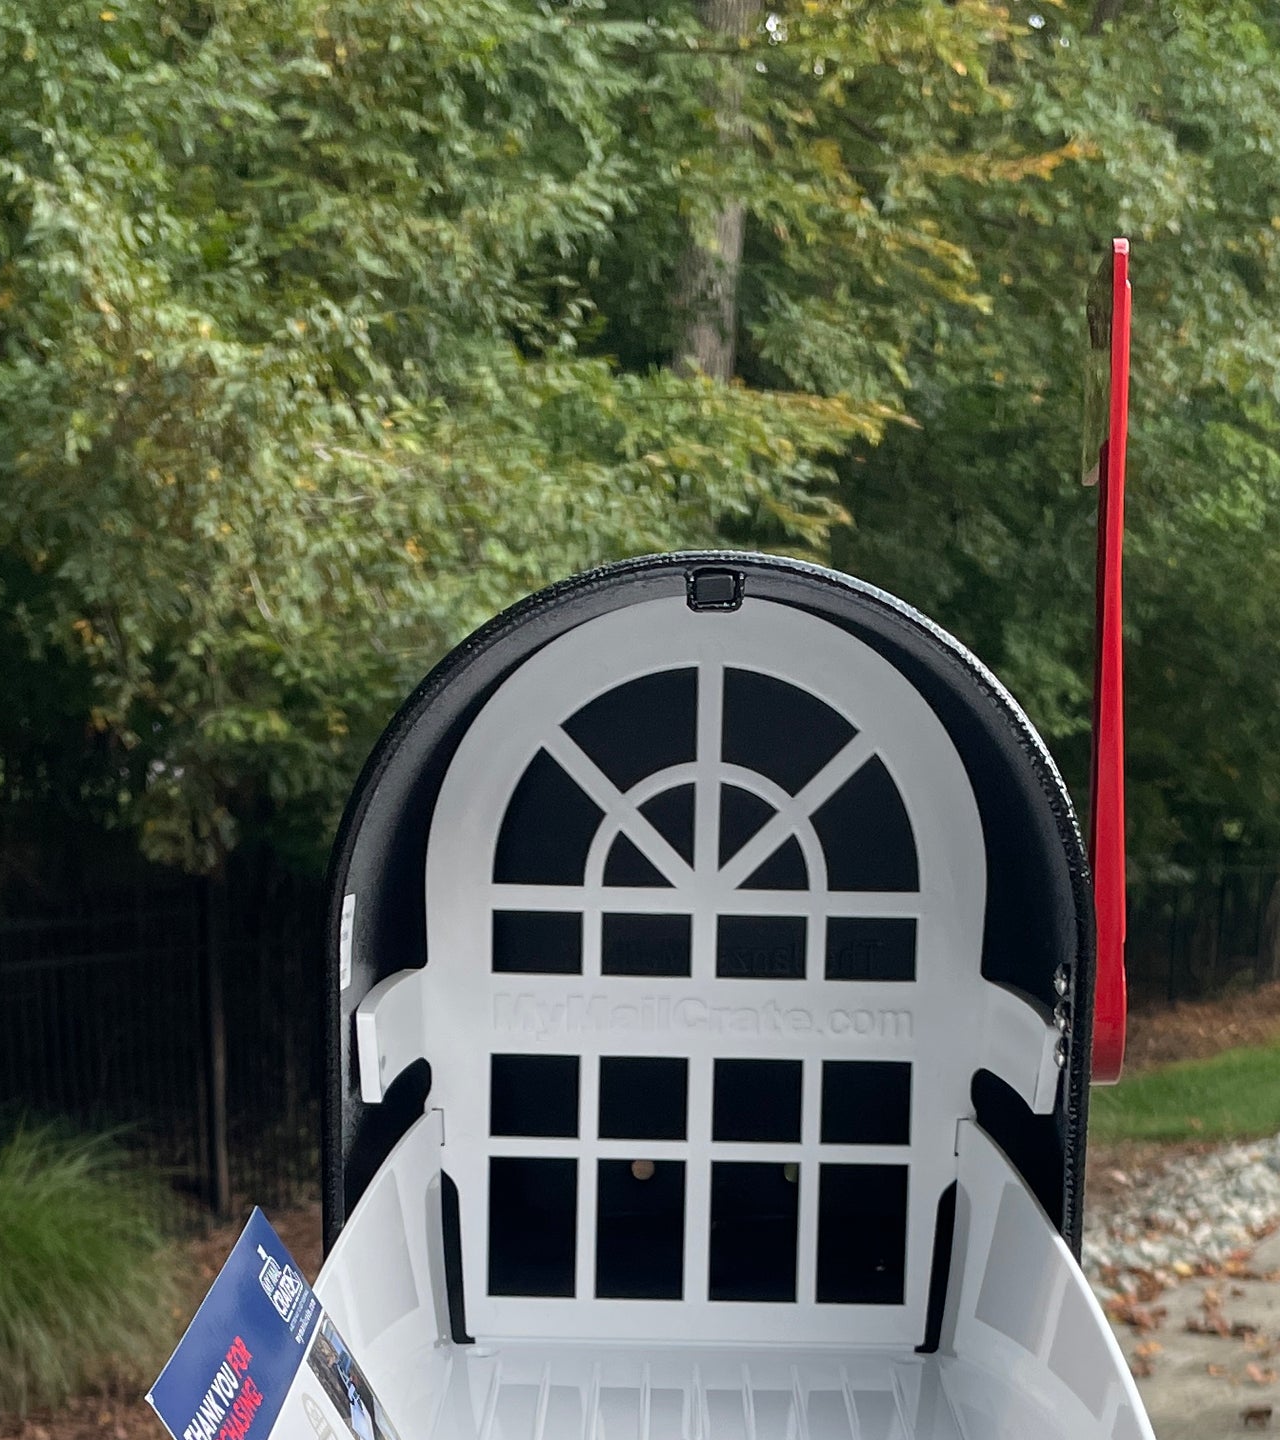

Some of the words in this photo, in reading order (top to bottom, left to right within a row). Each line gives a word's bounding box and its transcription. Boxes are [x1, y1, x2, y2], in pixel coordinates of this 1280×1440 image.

[490, 991, 916, 1043] MyMailCrate.com
[273, 1275, 296, 1315] CRATE
[211, 1362, 238, 1407] YOU
[226, 1336, 252, 1378] FOR
